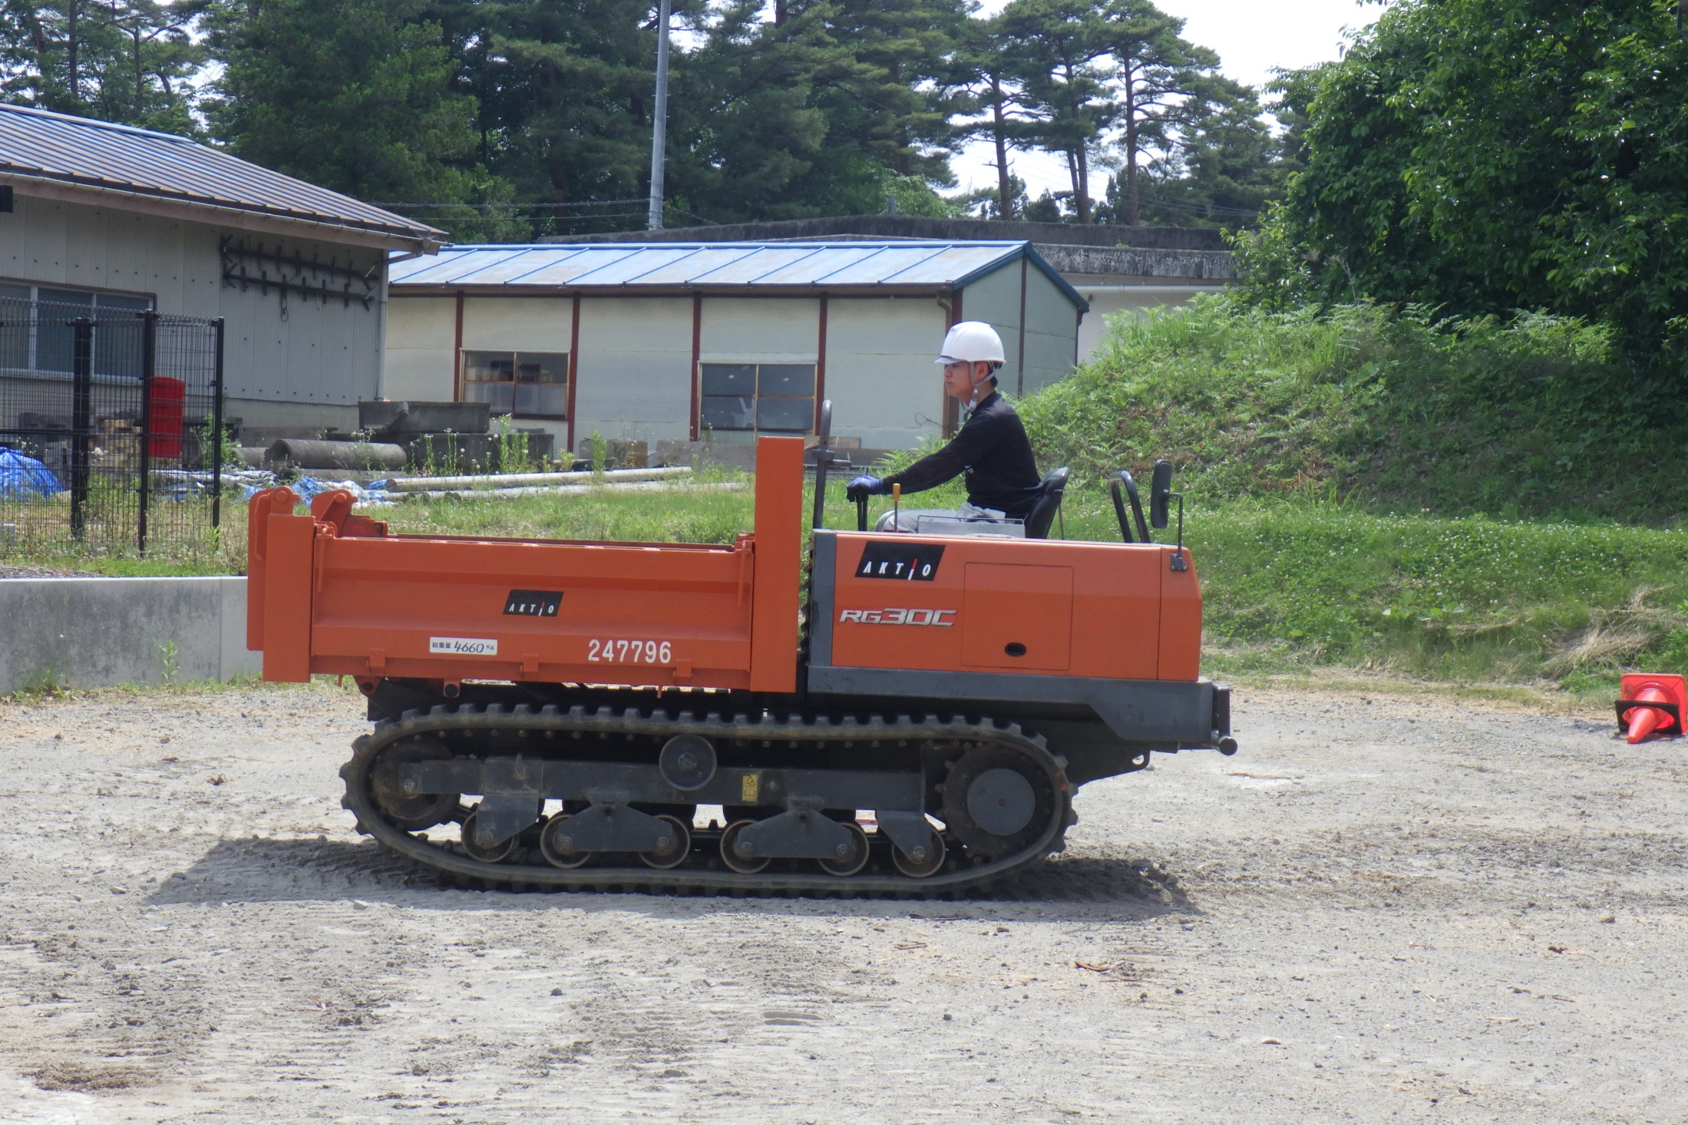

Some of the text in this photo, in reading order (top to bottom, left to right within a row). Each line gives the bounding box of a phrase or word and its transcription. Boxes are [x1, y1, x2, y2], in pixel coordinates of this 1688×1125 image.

[839, 608, 957, 627] RG30C
[454, 640, 485, 653] 4660
[588, 639, 671, 664] 247796
